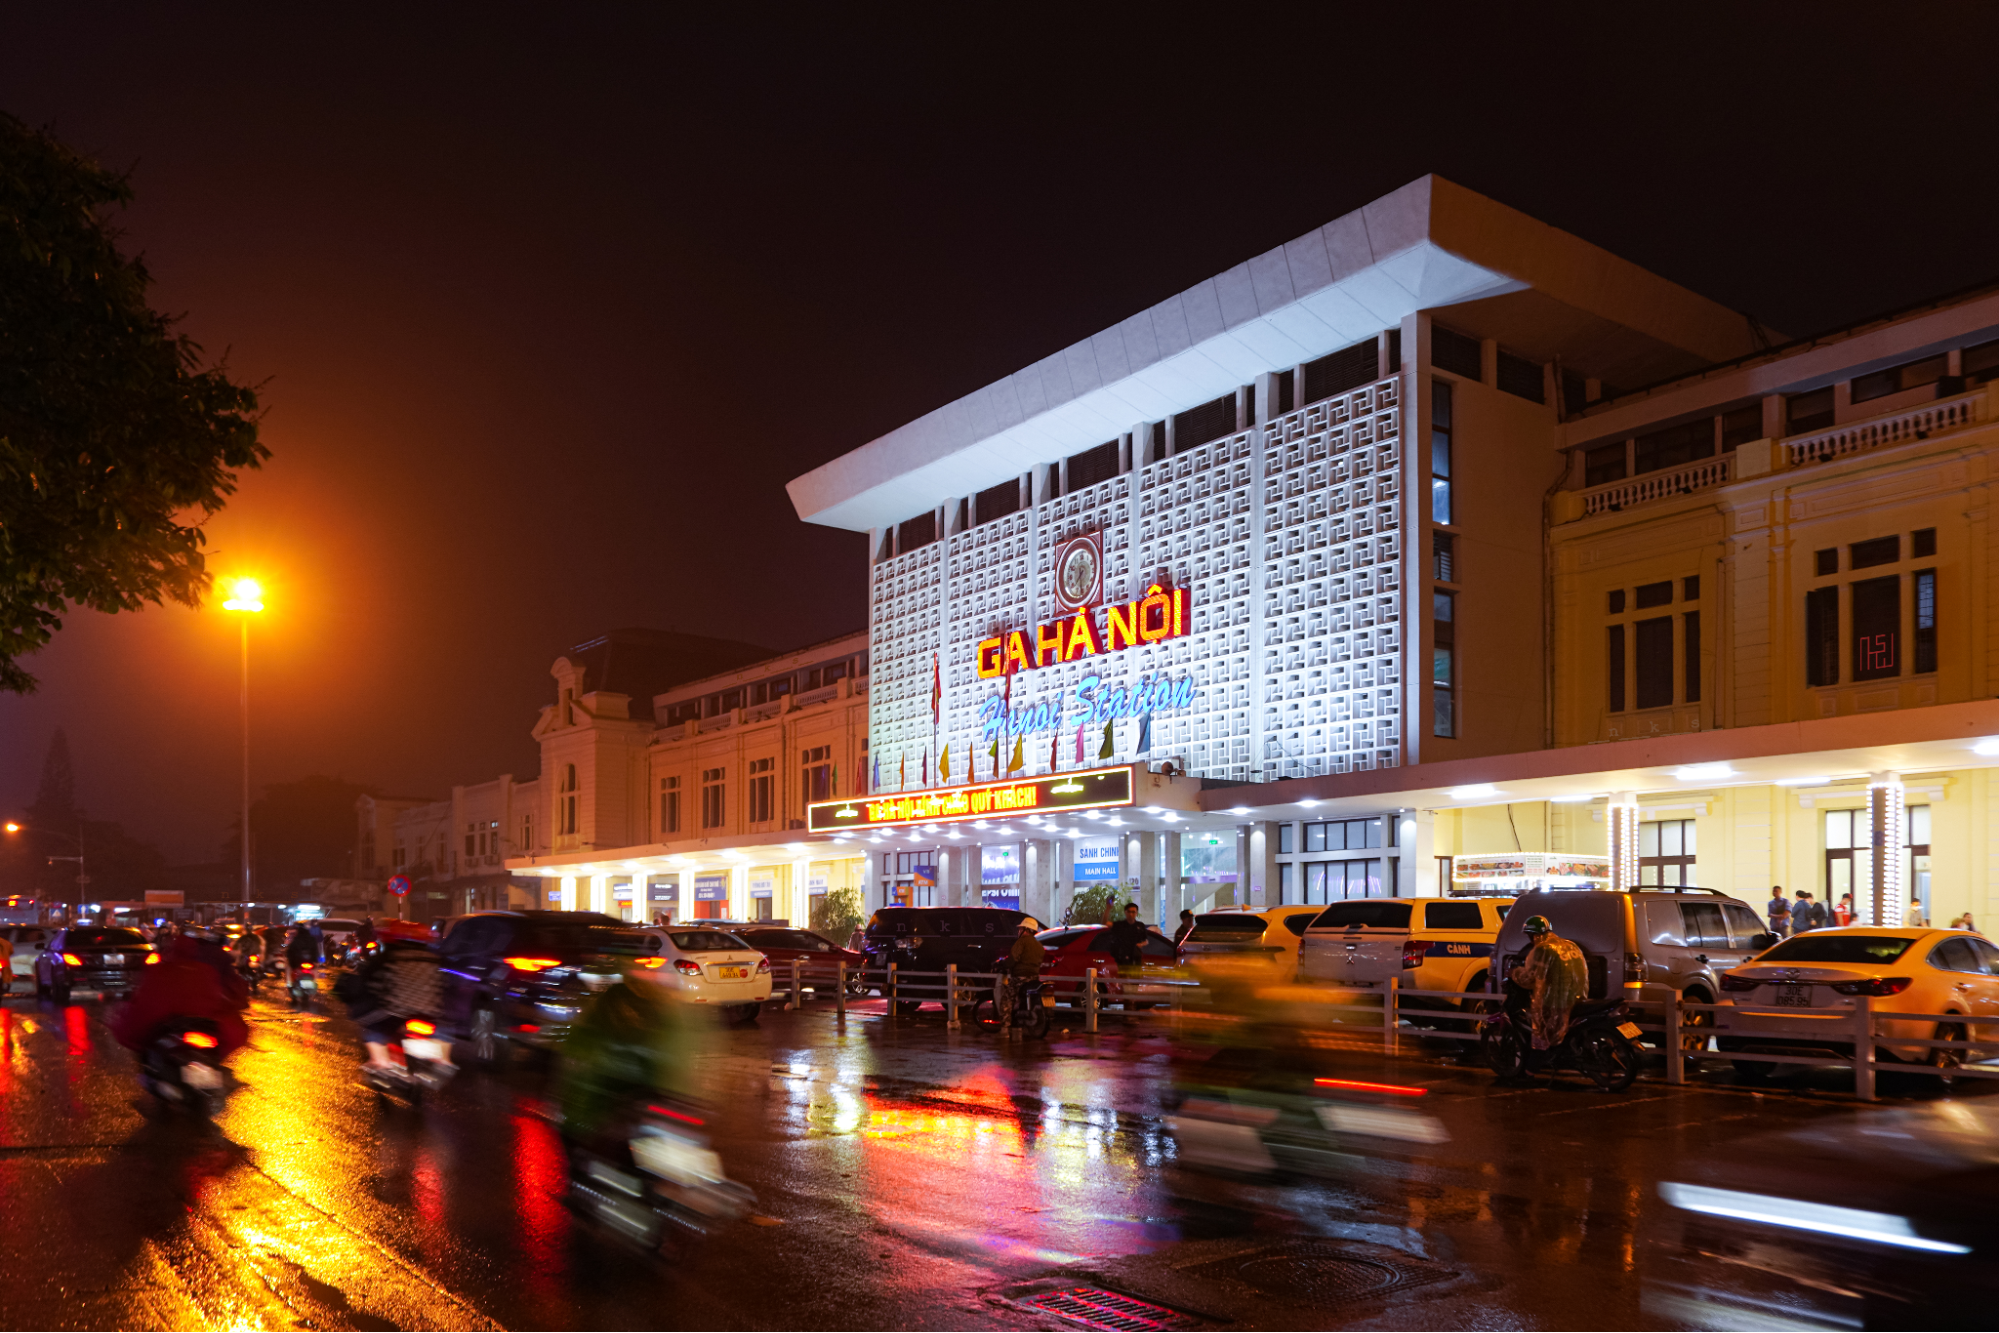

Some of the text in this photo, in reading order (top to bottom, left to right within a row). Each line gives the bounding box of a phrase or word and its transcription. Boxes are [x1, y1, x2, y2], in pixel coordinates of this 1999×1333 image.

[977, 583, 1183, 679] GA HÀ NỘI
[978, 671, 1197, 743] Hanoi Station
[970, 787, 992, 814] QUÝ
[1084, 867, 1116, 876] MAIN HALL
[1784, 985, 1804, 996] 30E
